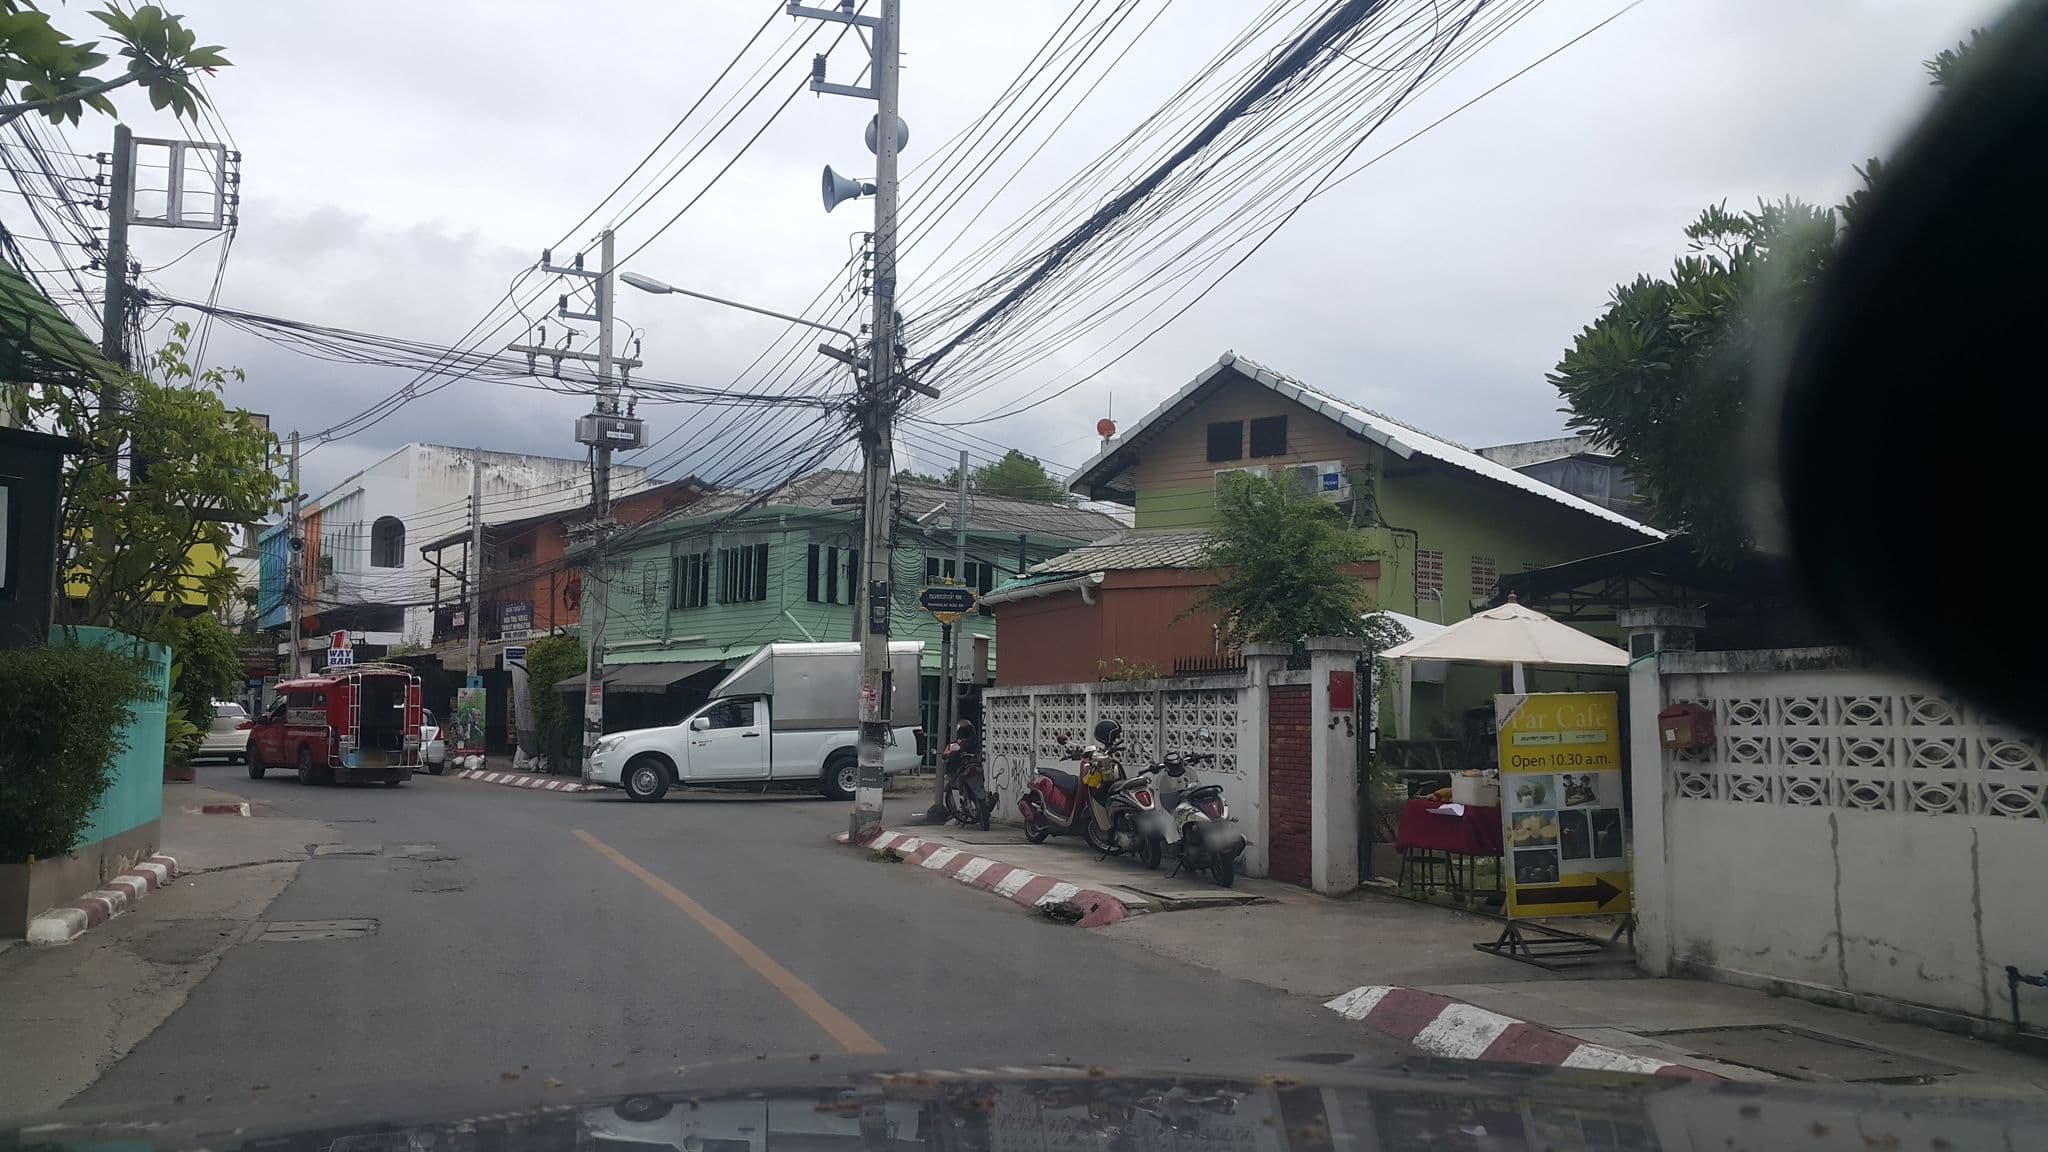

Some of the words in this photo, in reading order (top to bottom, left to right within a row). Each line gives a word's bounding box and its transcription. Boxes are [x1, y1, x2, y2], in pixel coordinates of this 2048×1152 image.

[330, 649, 352, 657] WAY
[330, 657, 352, 665] BAR
[1512, 707, 1548, 729] Par
[1511, 754, 1546, 770] Open
[1550, 753, 1583, 766] 10.30
[1585, 754, 1612, 765] a.m.
